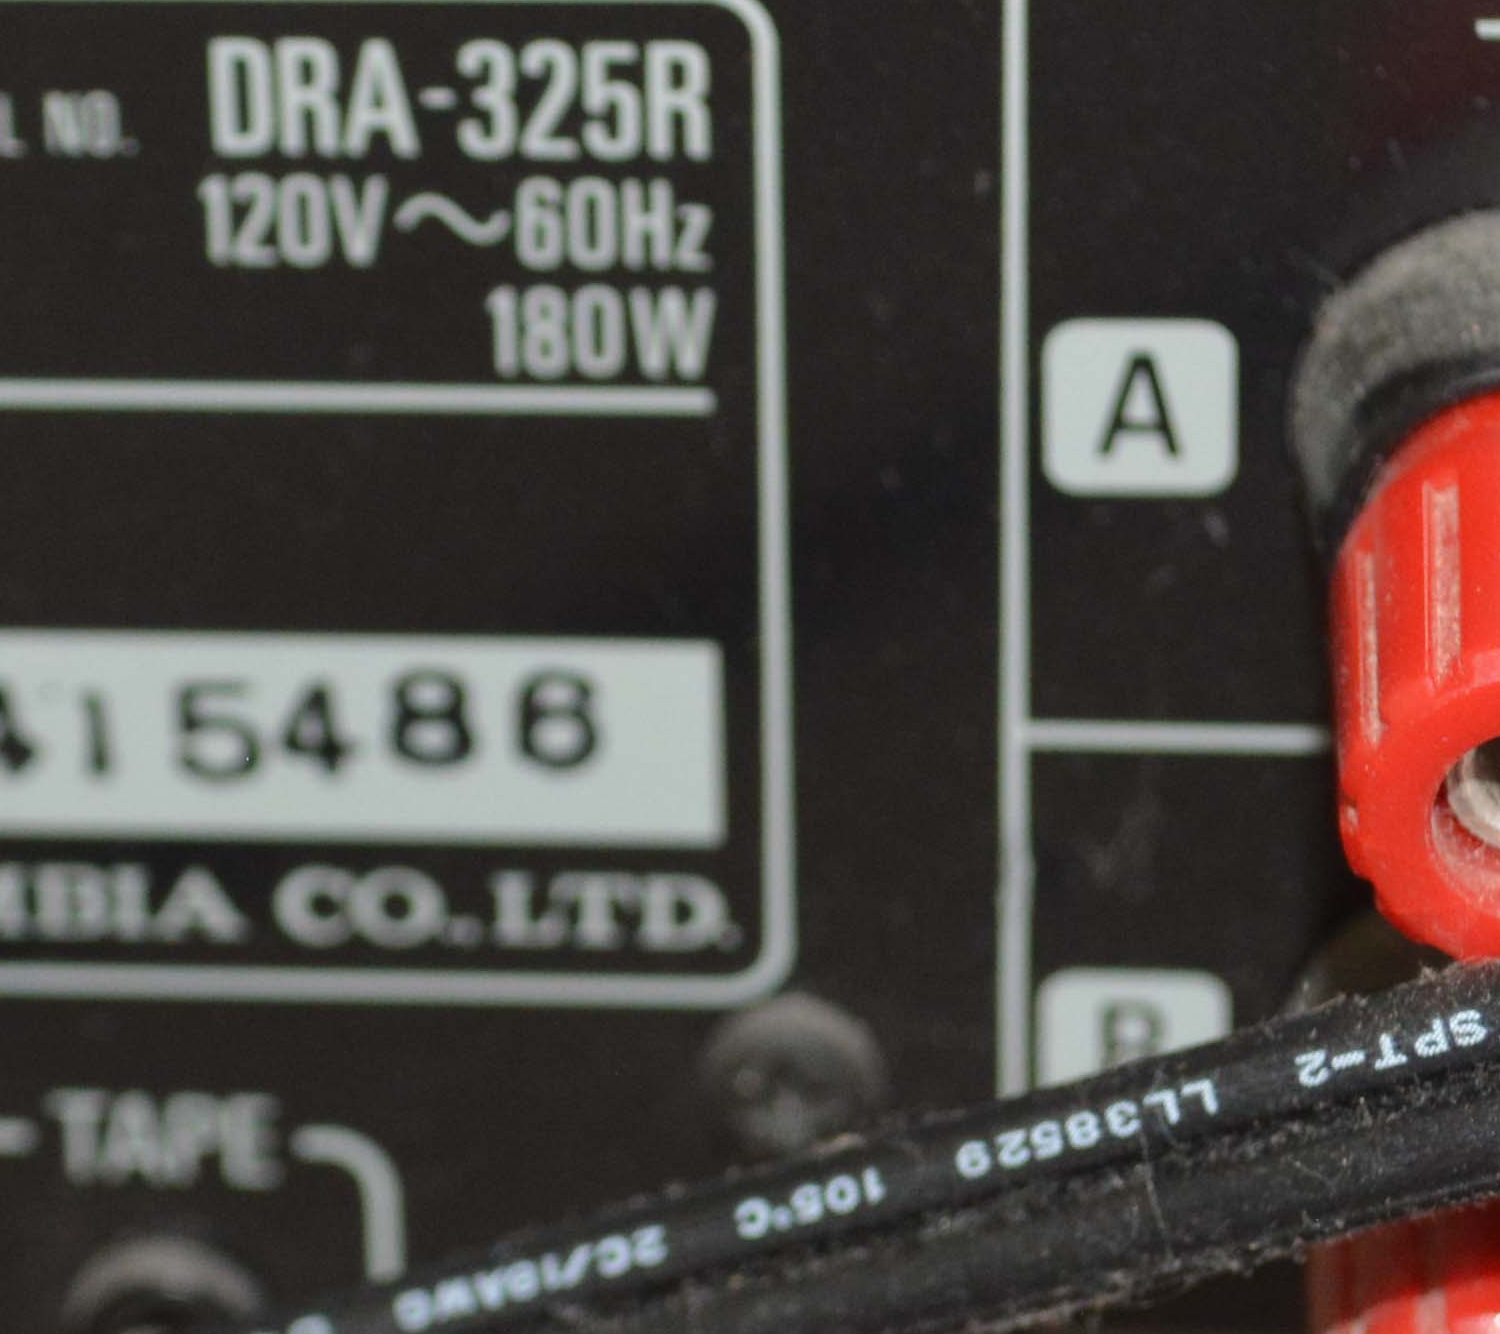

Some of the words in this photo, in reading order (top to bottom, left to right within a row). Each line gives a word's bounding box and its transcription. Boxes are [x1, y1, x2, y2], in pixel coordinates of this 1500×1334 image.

[43, 91, 137, 156] NO.
[208, 37, 710, 160] DRA-325R
[487, 284, 714, 378] 180W
[1096, 350, 1182, 458] A
[1295, 1009, 1489, 1087] SPT-2
[51, 1090, 274, 1187] TAPE
[955, 1078, 1219, 1178] LL38529
